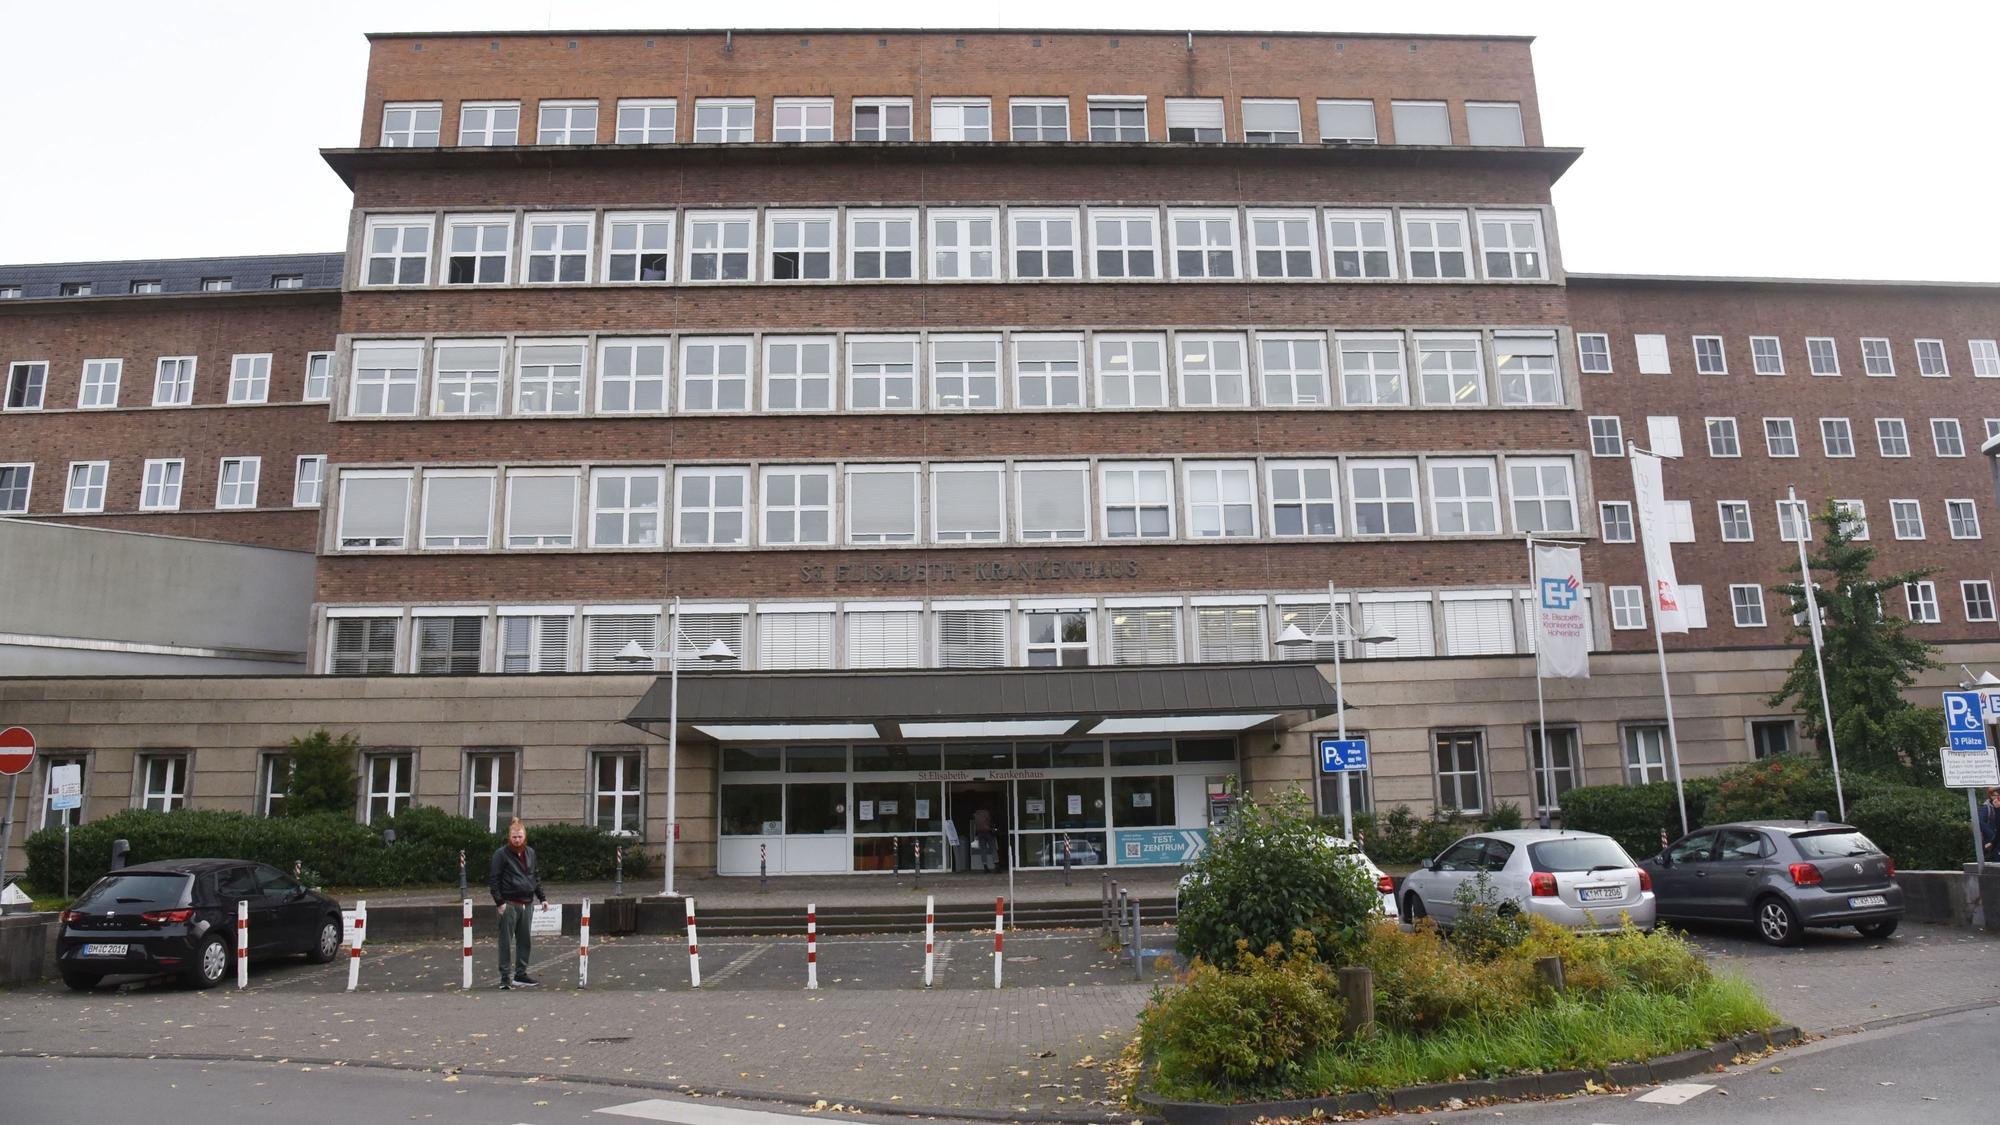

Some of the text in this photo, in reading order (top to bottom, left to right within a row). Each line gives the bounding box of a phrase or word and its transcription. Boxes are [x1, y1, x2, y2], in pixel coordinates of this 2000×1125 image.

[1947, 696, 1968, 725] P
[1954, 737, 1982, 745] 3 Plätze
[1325, 747, 1337, 764] P
[989, 770, 1044, 779] Krankenhaus
[1152, 835, 1176, 843] TEST-
[1143, 843, 1185, 852] ZENTRUM
